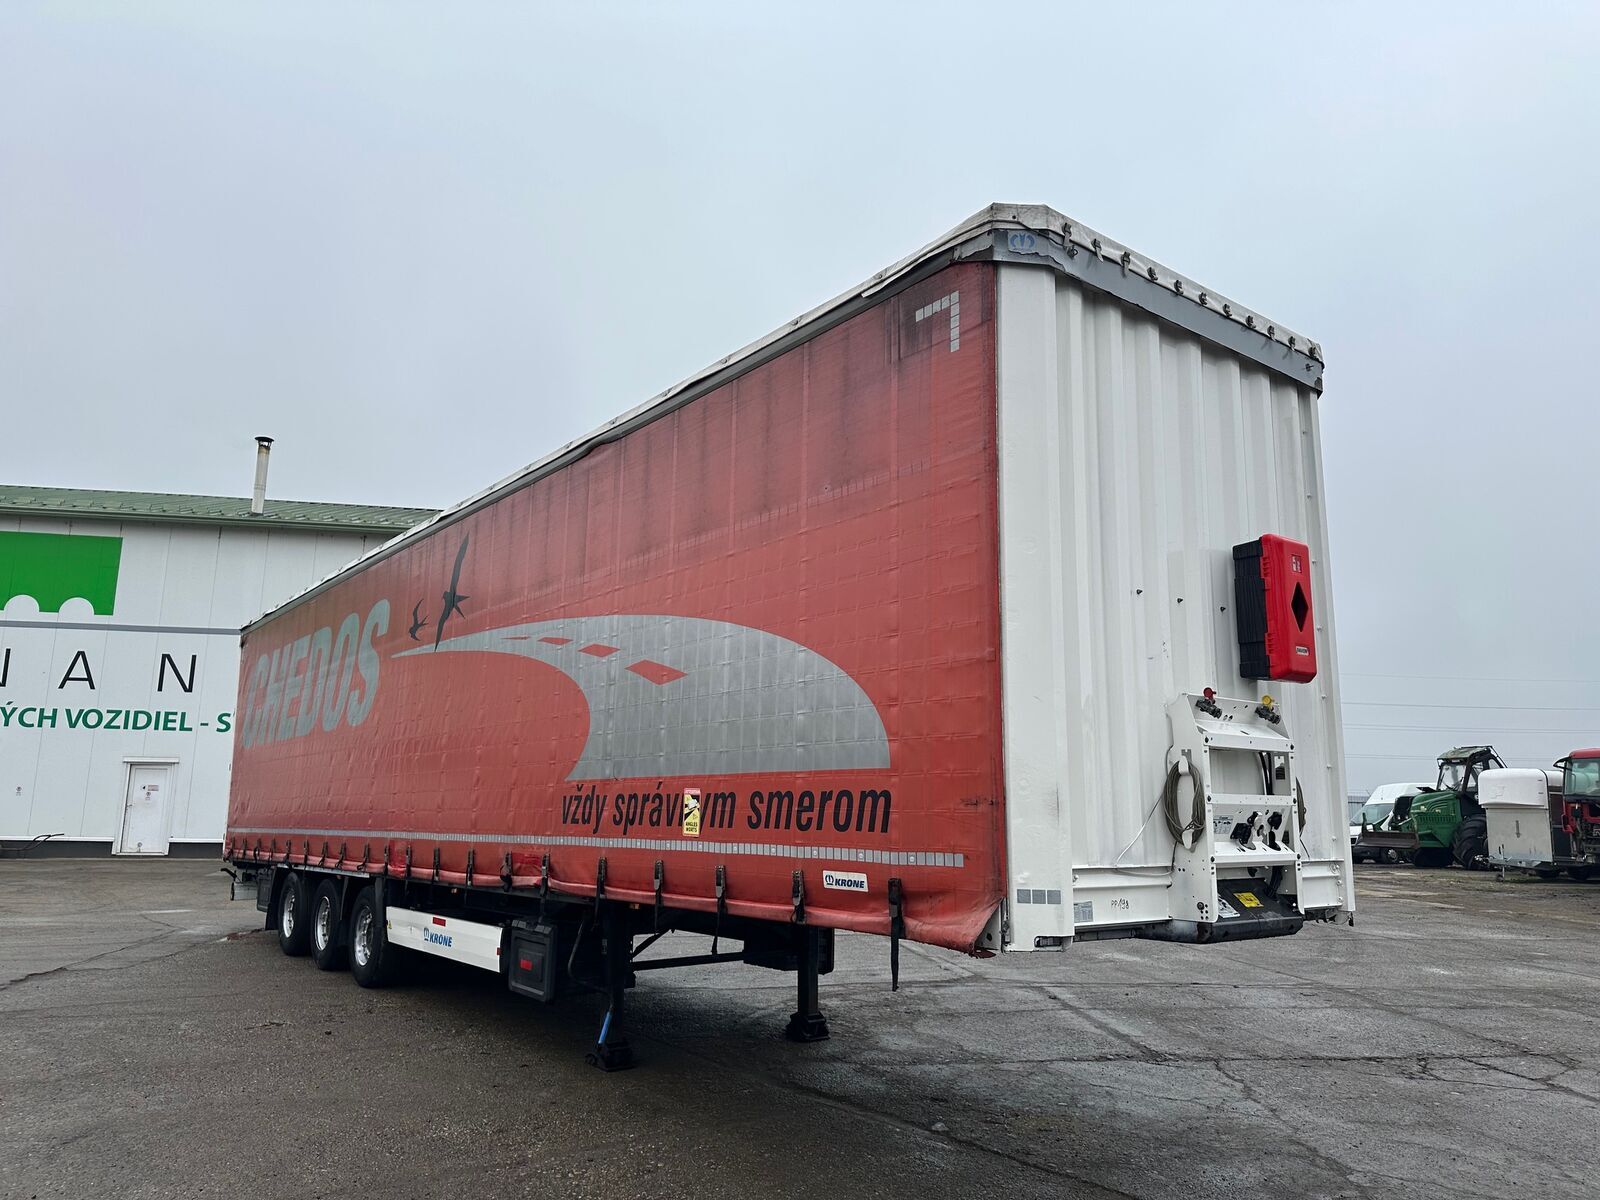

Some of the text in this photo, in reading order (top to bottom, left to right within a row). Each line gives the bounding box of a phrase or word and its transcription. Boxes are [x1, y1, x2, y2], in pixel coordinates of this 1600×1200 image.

[65, 708, 193, 732] VOZIDIEL
[562, 781, 892, 836] vždy správym smerom
[834, 878, 865, 889] KRONE
[429, 932, 453, 947] KRONE
